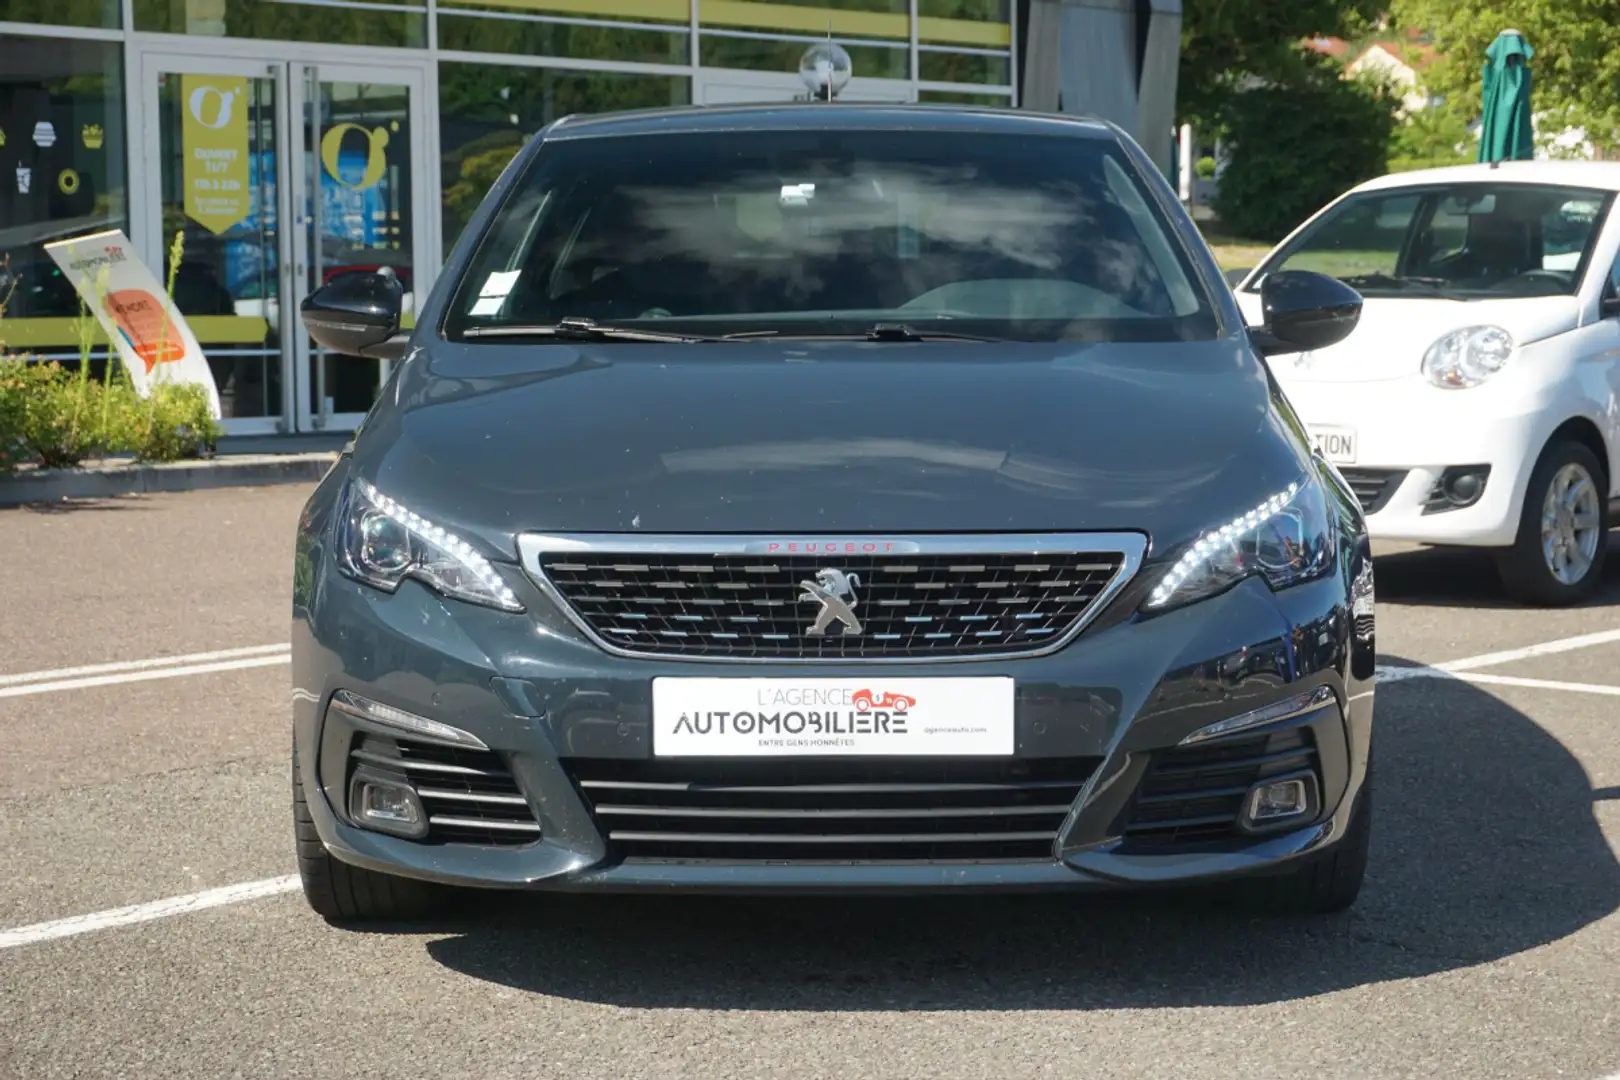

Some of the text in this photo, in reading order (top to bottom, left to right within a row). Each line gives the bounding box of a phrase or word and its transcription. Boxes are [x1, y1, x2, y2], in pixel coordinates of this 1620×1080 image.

[767, 542, 896, 553] PEUGEOT
[757, 688, 852, 706] L'AGENCE
[923, 725, 988, 735] agenceauto.com
[758, 738, 784, 747] ENTRE
[786, 738, 809, 747] GENS
